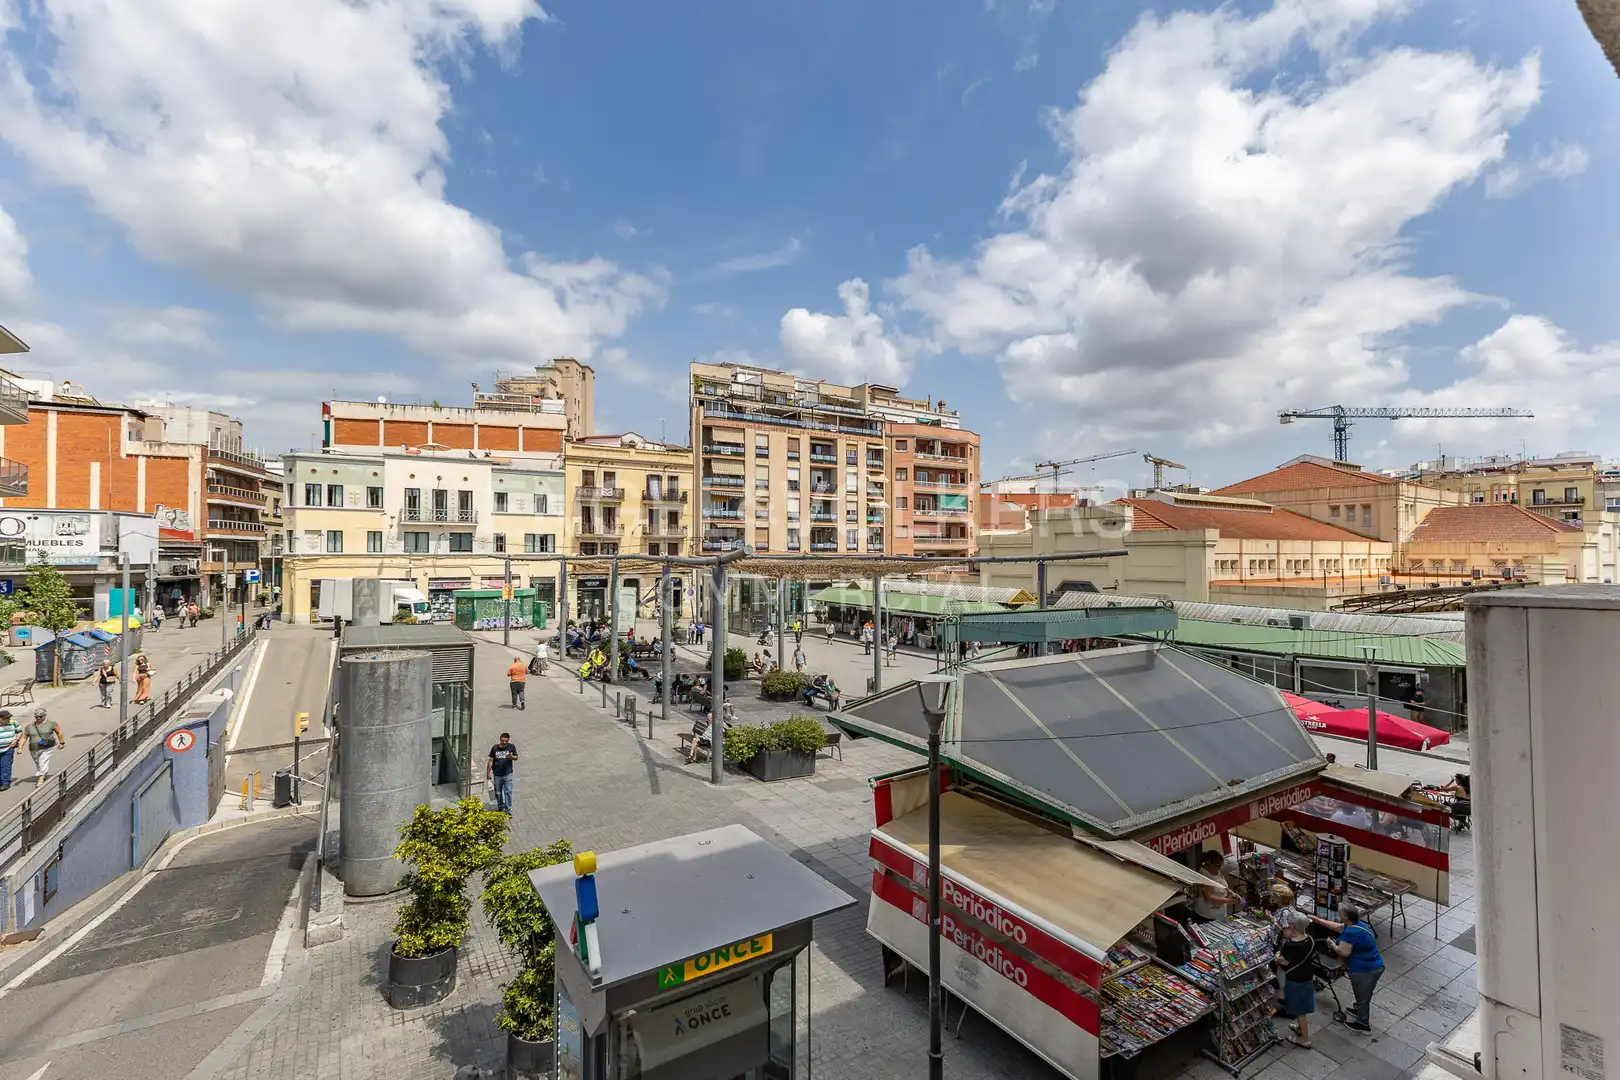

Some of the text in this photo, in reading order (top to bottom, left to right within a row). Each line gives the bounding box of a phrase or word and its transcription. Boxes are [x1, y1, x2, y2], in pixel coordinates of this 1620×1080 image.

[246, 570, 260, 581] P
[1269, 786, 1311, 812] Periódico
[1163, 822, 1216, 856] Periódico
[942, 878, 1028, 945] Periódico
[694, 939, 763, 971] ONCE
[942, 915, 1028, 987] Periódico
[684, 996, 727, 1017] grup social
[688, 1004, 732, 1030] ONCE
